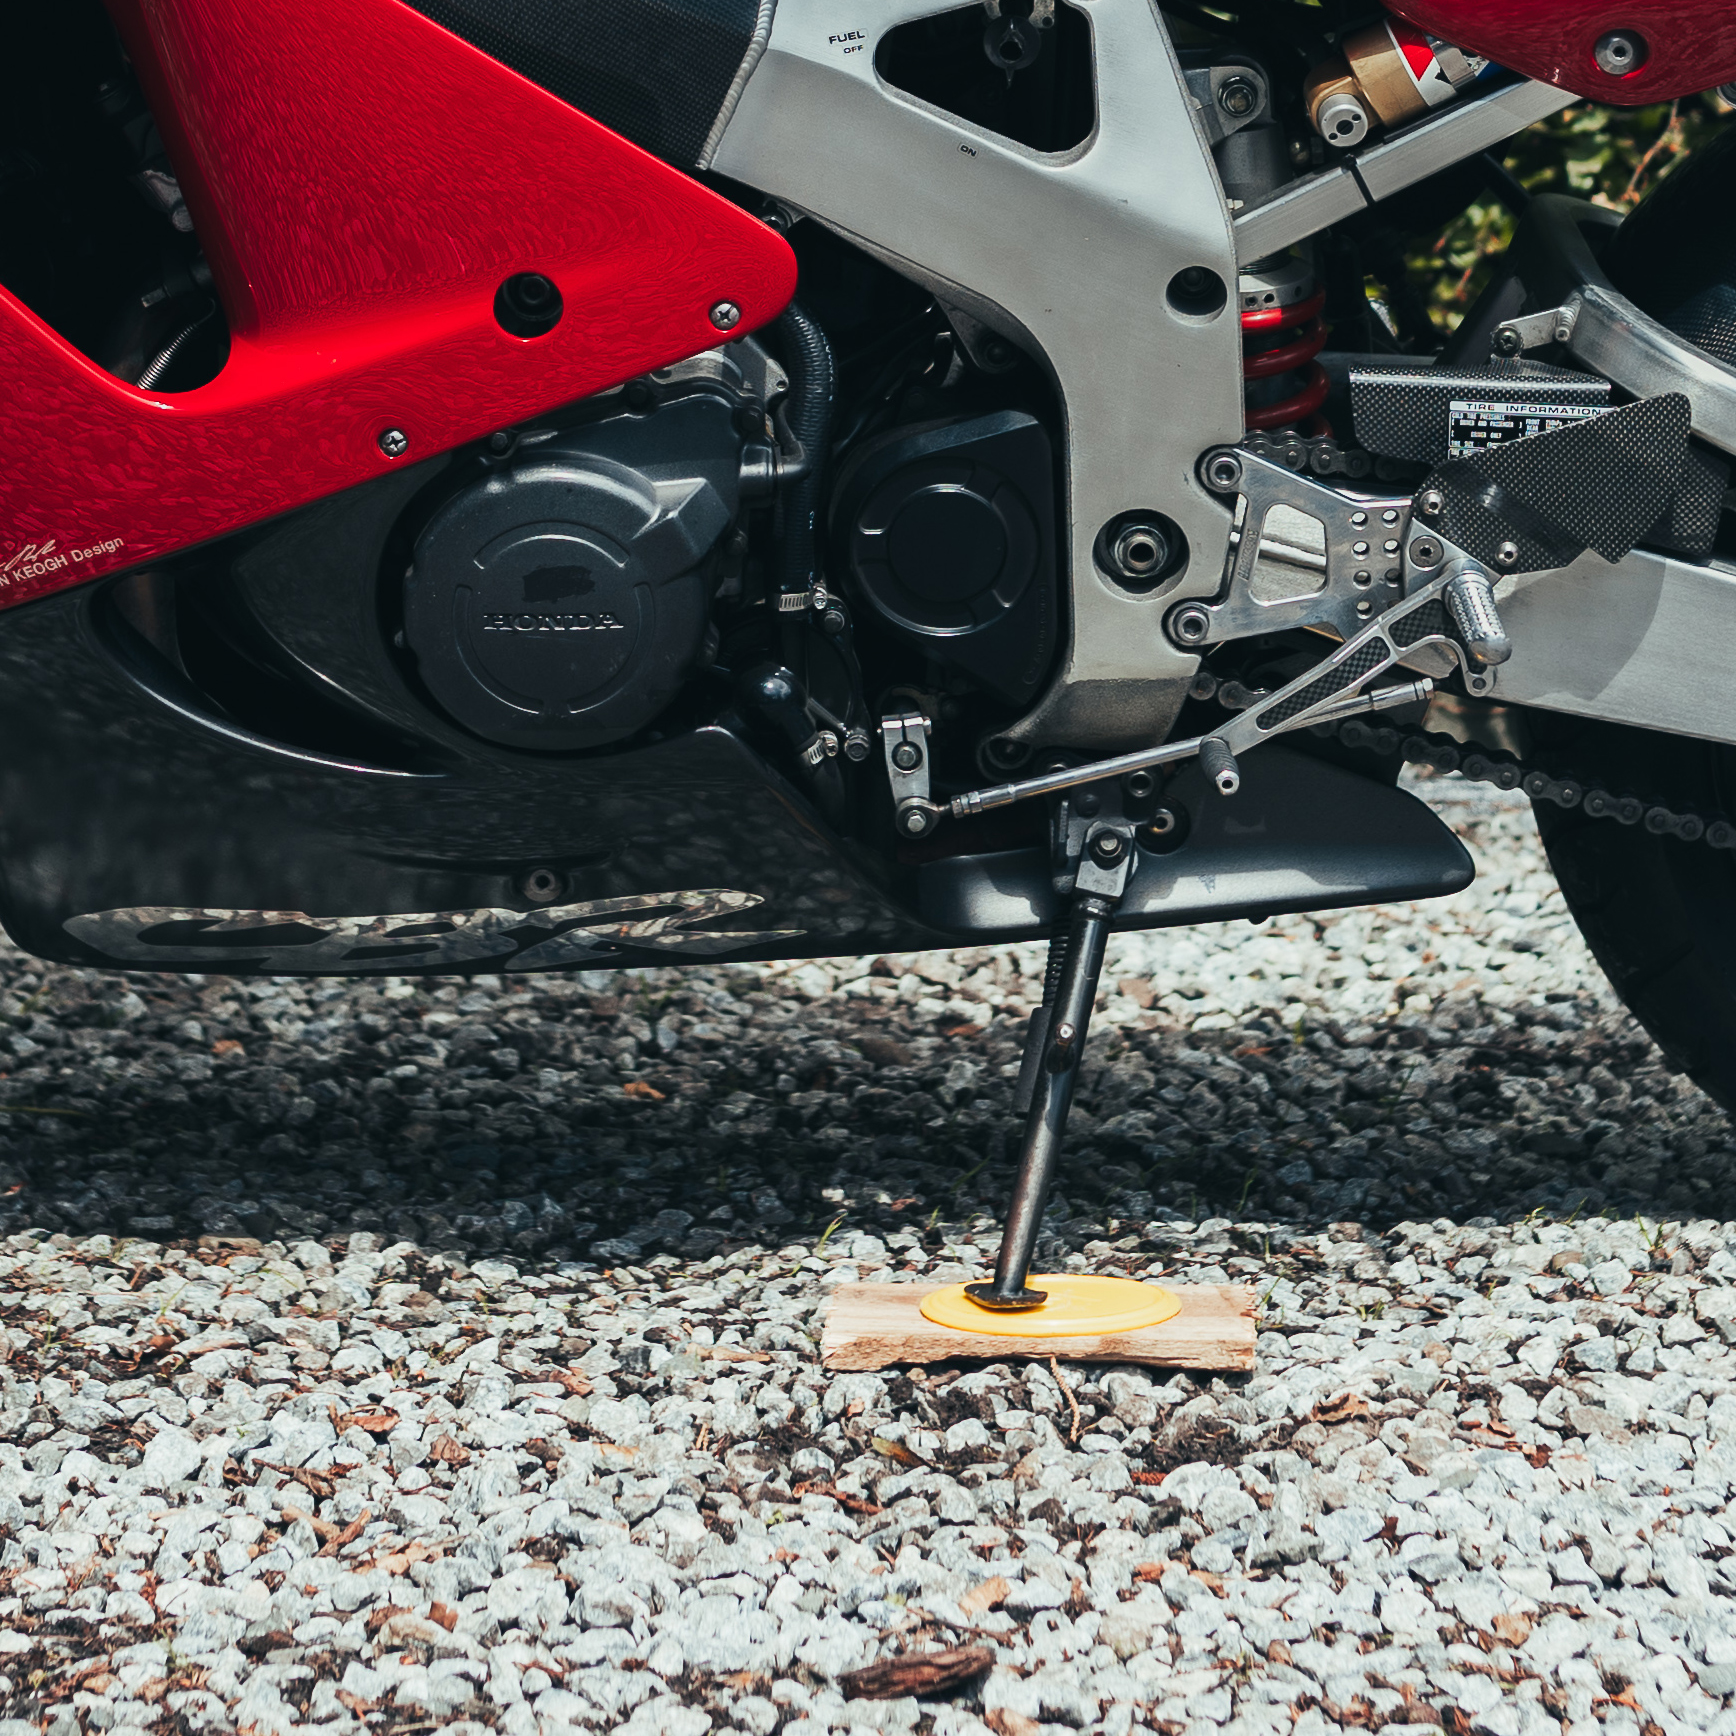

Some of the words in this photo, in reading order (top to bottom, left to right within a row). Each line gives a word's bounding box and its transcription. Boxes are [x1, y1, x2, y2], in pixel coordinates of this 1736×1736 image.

[829, 30, 865, 44] FUEL
[843, 44, 864, 54] OFF
[960, 145, 977, 157] ON
[1466, 403, 1495, 412] TIRE
[1506, 405, 1601, 416] INFORMATION
[12, 555, 68, 582] KEOGH
[70, 537, 125, 563] Design
[483, 613, 624, 631] HONDA
[63, 887, 807, 971] CBR
